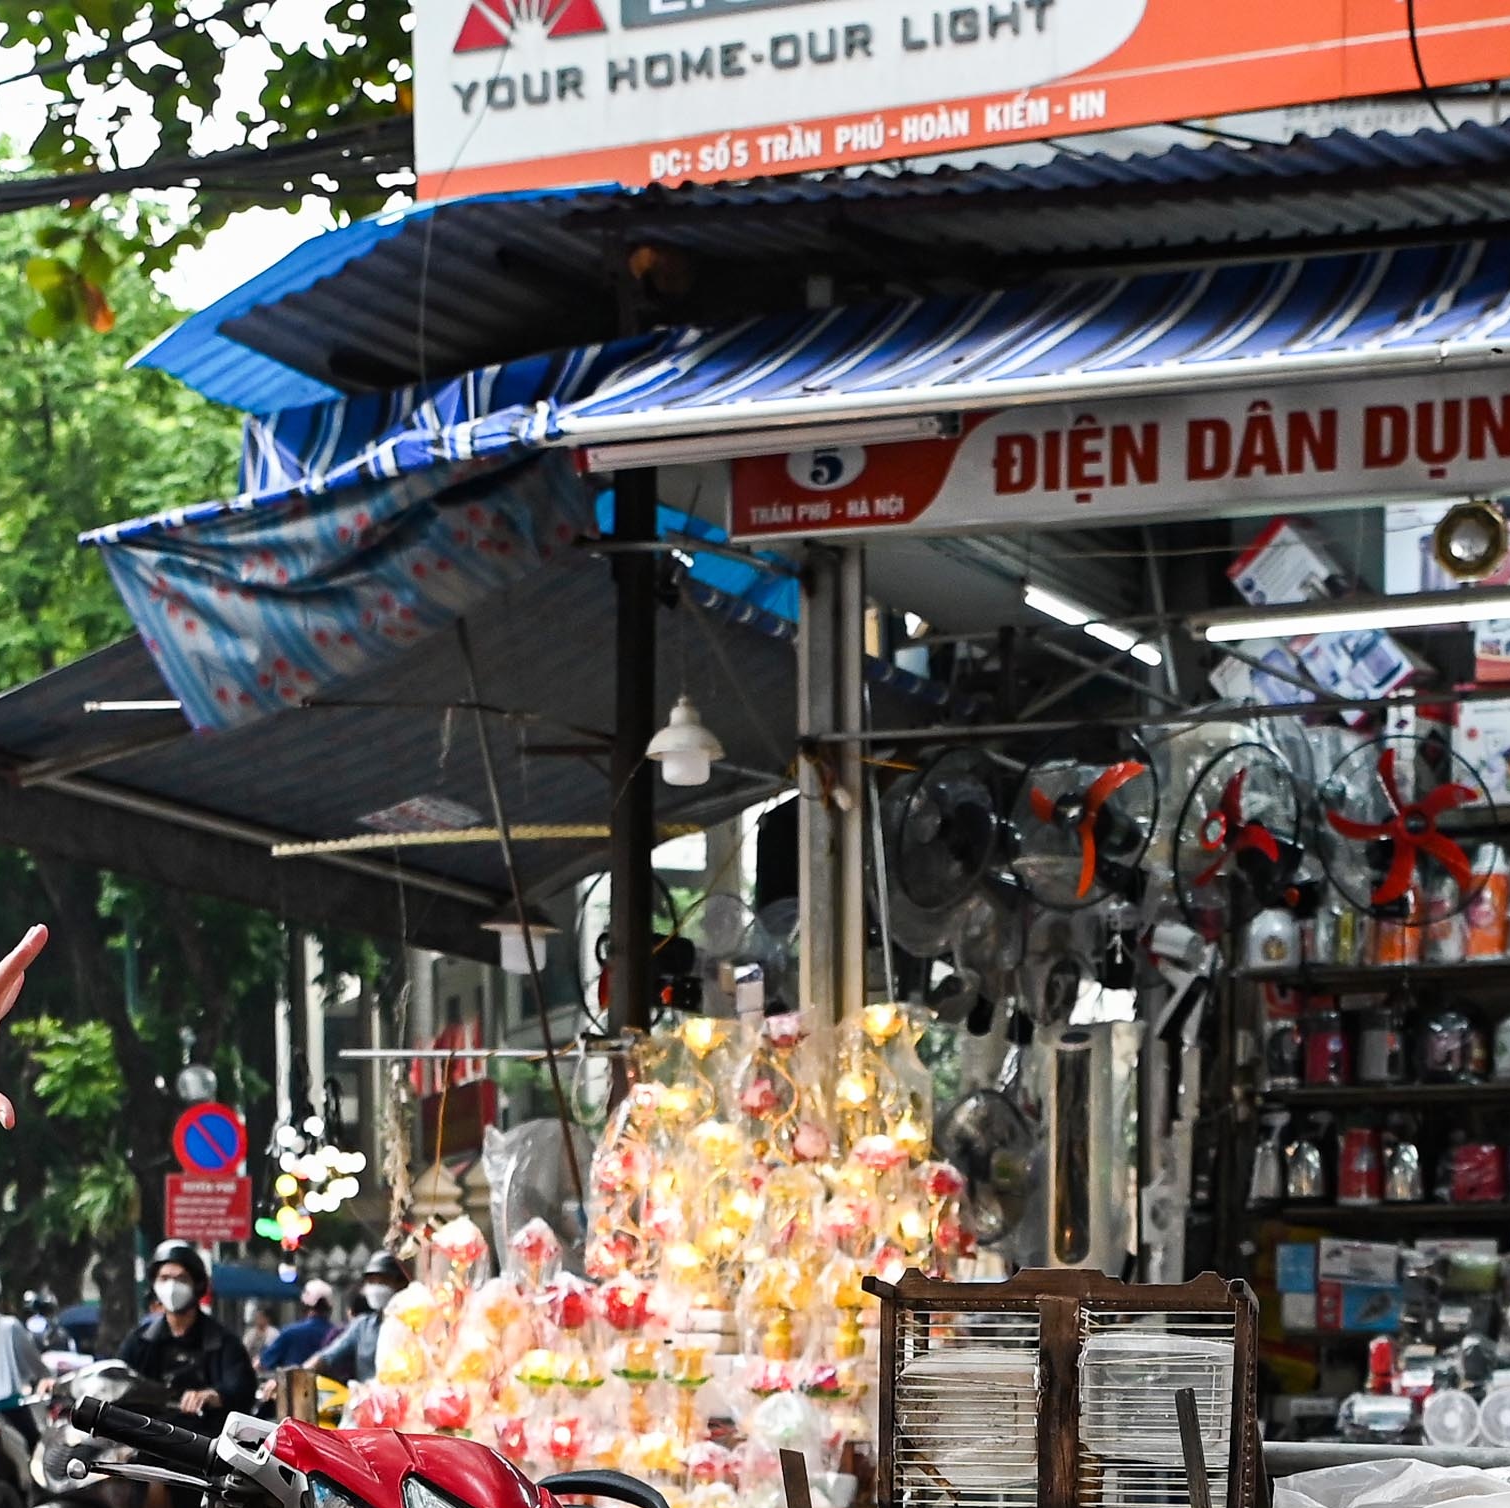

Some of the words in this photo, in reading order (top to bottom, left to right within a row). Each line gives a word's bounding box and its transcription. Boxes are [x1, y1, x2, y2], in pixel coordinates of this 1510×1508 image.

[452, 66, 585, 114] YOUR
[901, 0, 1053, 50] LIGHT
[650, 148, 691, 180] ĐC:
[757, 124, 822, 164] TRẦN
[810, 448, 844, 486] 5
[993, 414, 1160, 503] ĐIỆN
[1187, 400, 1338, 482] DÂN
